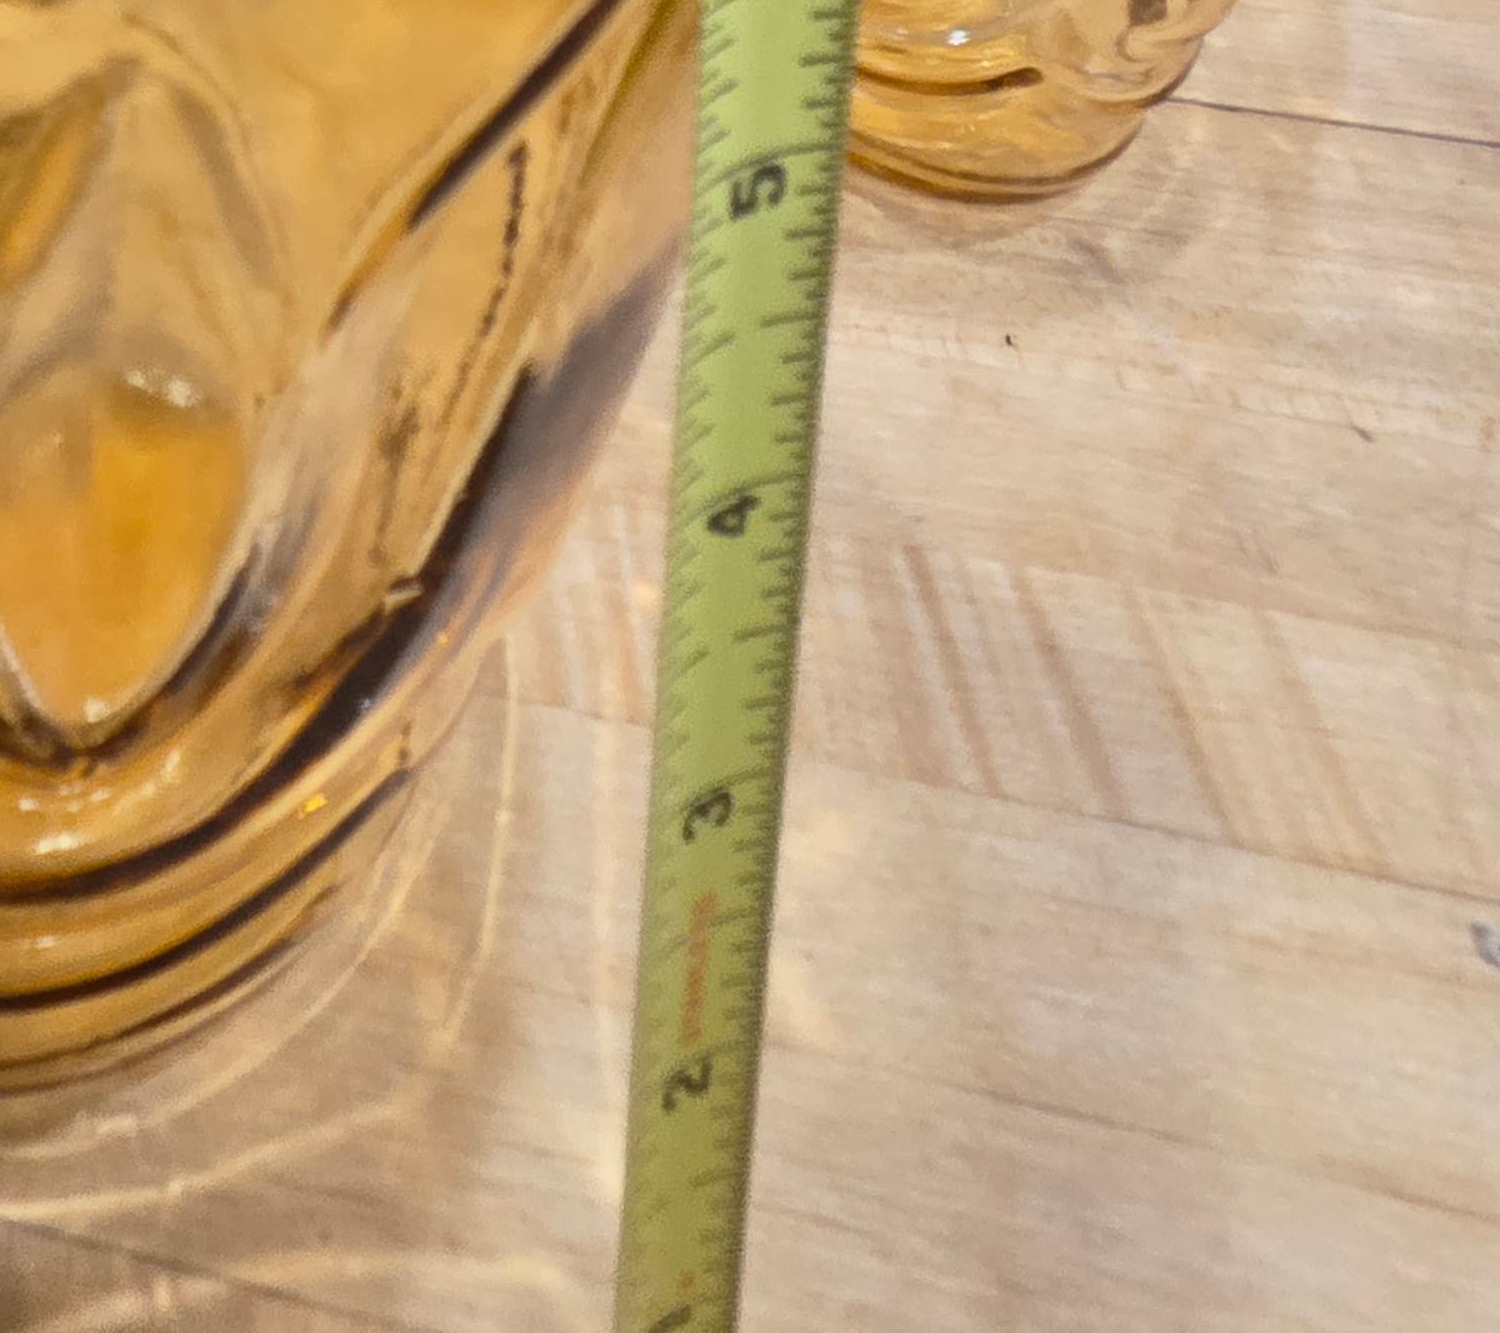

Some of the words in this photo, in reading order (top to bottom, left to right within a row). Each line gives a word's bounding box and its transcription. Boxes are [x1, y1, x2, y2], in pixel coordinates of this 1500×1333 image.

[728, 162, 786, 220] 5
[707, 494, 760, 537] 4
[682, 789, 734, 845] 3
[661, 1055, 712, 1111] 2
